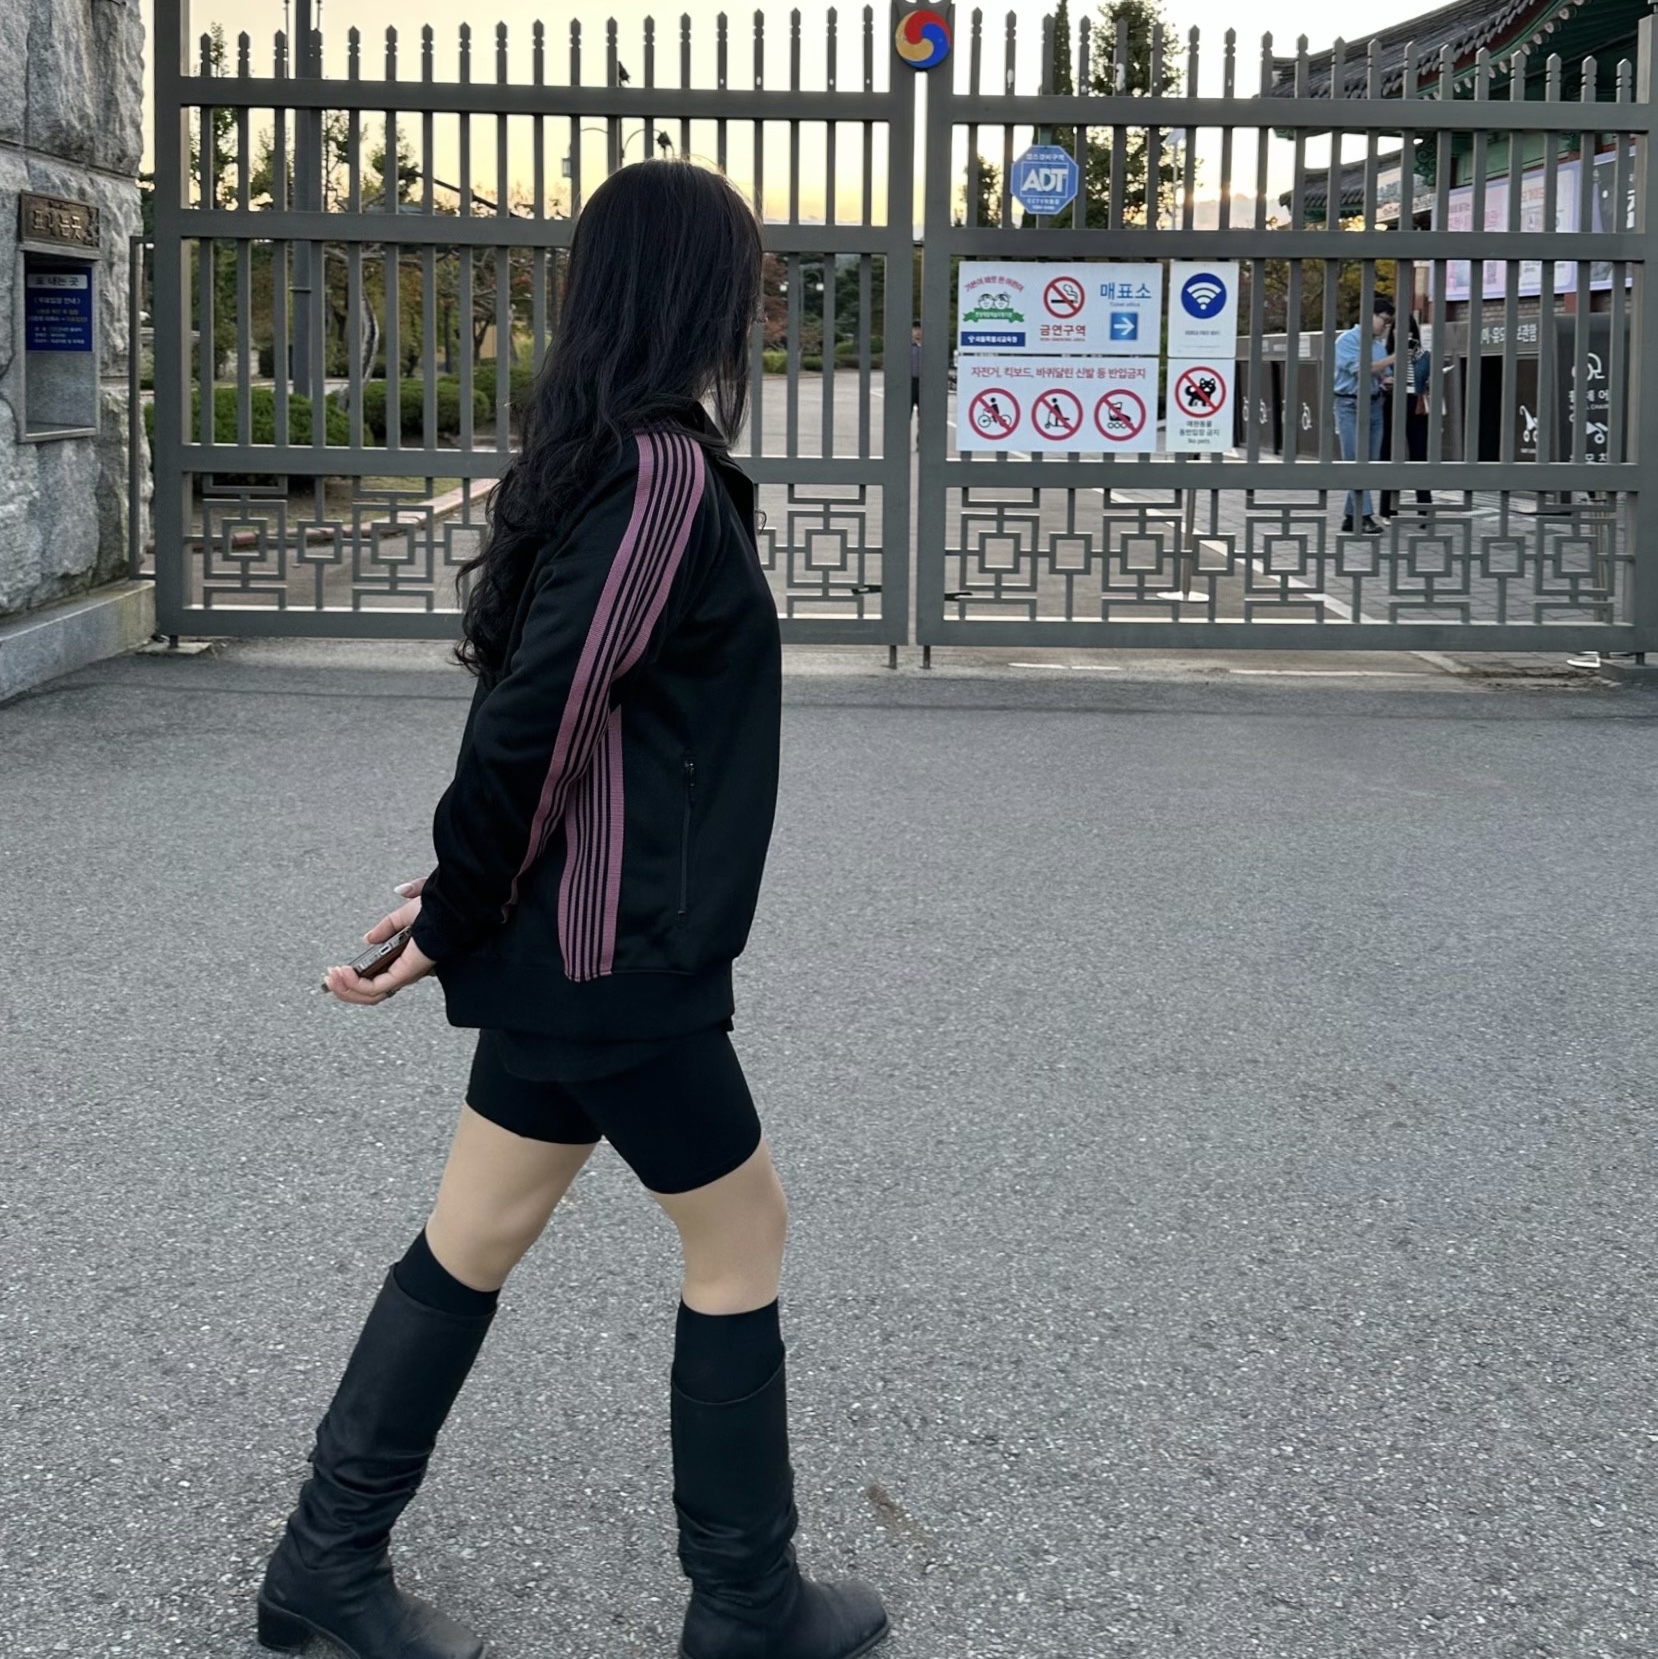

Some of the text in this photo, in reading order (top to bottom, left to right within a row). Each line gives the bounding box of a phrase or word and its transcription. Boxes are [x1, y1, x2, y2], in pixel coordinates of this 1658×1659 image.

[1021, 168, 1069, 193] ADT
[47, 276, 67, 286] 내는
[69, 276, 79, 287] 곳
[1100, 282, 1151, 300] 매표소
[1040, 324, 1086, 337] 금연구역
[1036, 367, 1074, 379] 바퀴달린
[1077, 367, 1095, 379] 신발
[1097, 367, 1106, 379] 등
[1108, 368, 1146, 379] 반입금지
